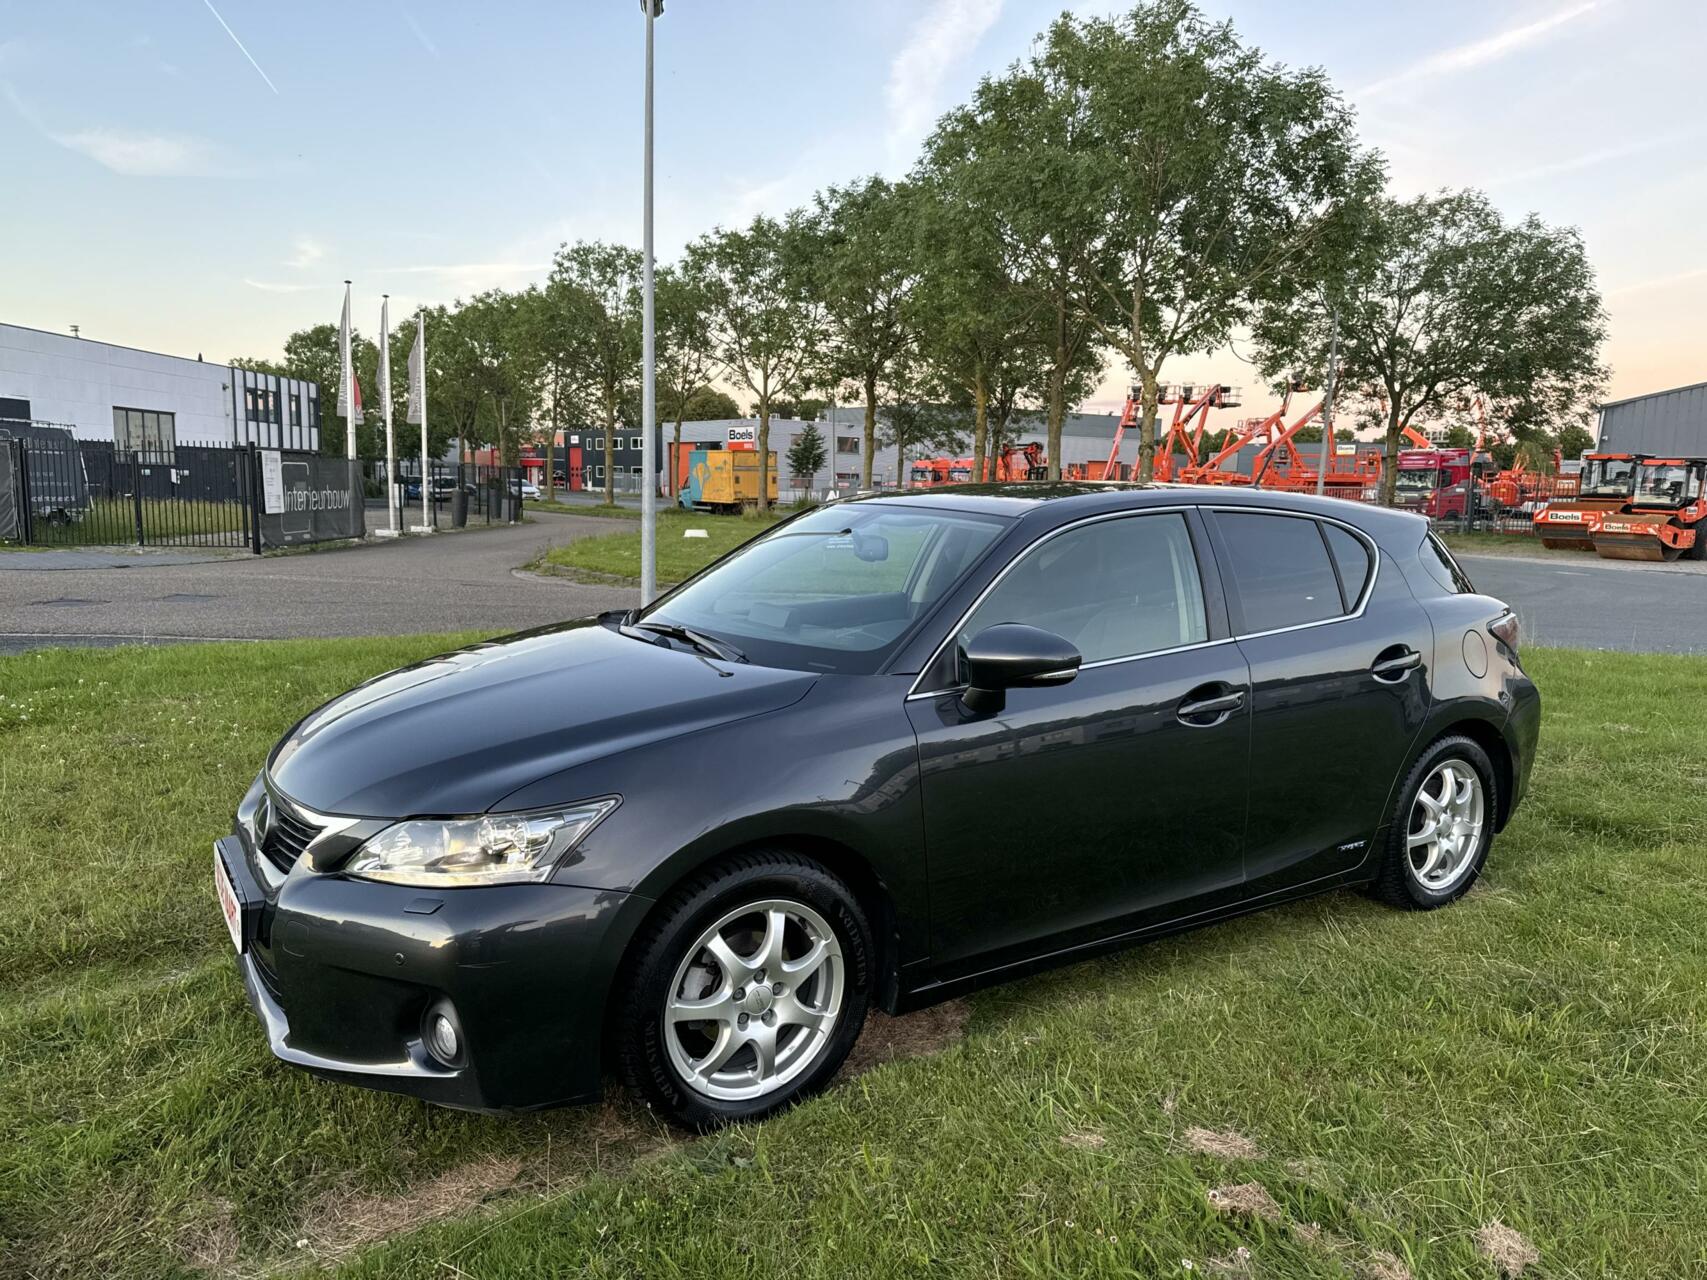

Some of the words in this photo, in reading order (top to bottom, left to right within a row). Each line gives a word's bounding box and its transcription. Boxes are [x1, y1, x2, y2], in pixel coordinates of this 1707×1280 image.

[729, 429, 753, 440] Boels
[284, 484, 350, 512] Interieurbouw
[1550, 513, 1580, 521] Boels
[1605, 523, 1629, 531] Boels
